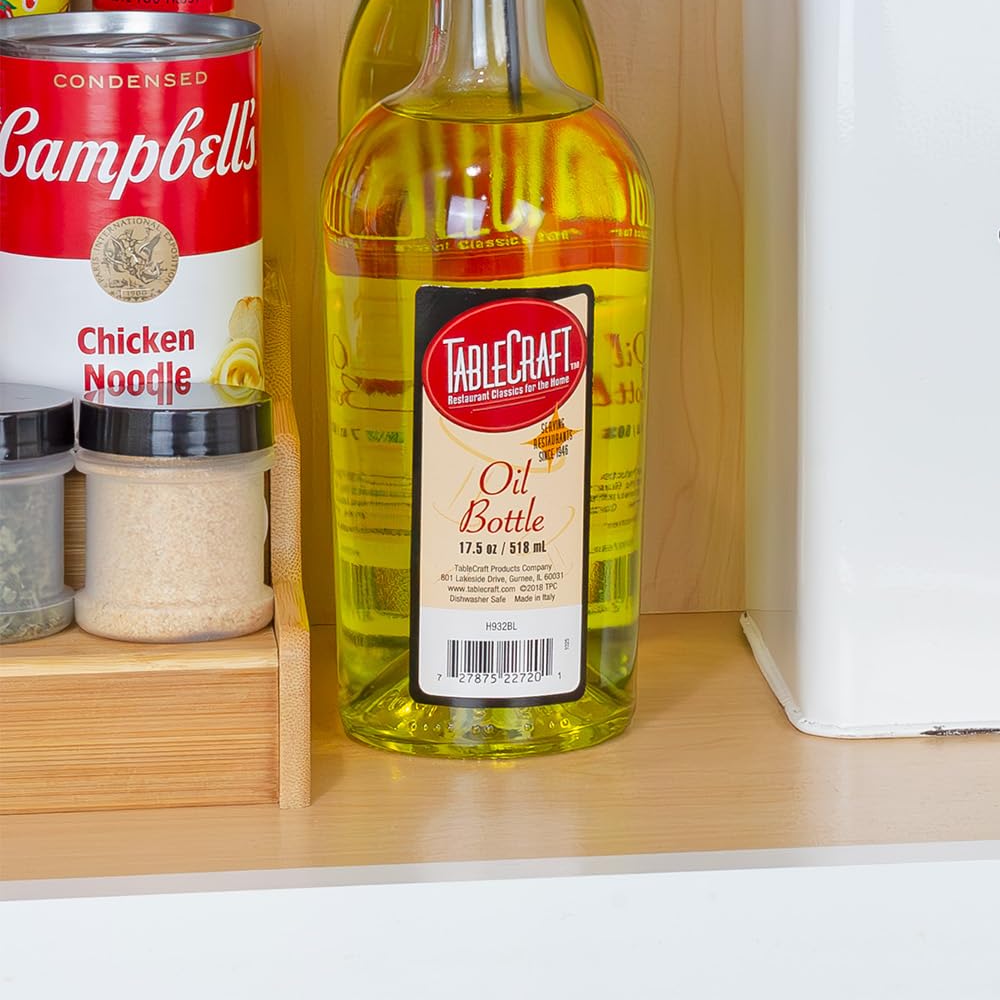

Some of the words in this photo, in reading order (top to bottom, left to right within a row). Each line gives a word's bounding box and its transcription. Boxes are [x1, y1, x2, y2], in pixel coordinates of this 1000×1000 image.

[53, 71, 208, 89] CONDENSED
[93, 217, 162, 252] INTERNATIONAL
[77, 325, 195, 355] Chicken
[84, 361, 192, 396] Noodle
[447, 390, 490, 405] Restaurant
[491, 386, 524, 400] Classics
[524, 383, 537, 393] for
[537, 380, 549, 390] the
[550, 375, 570, 387] Home
[541, 417, 565, 434] SERVING
[533, 429, 573, 450] RESTAURANTS
[480, 459, 532, 495] Oil
[459, 496, 545, 534] Bottle
[459, 541, 483, 554] 17.5
[486, 543, 497, 554] oz
[509, 541, 530, 554] 518
[533, 540, 547, 553] mL
[454, 564, 489, 573] TableCraft
[490, 565, 520, 573] Products
[522, 564, 552, 572] Company
[455, 575, 486, 583] Lakeside
[509, 574, 535, 583] Gurnee,
[544, 572, 564, 581] 60031
[448, 585, 516, 593] www.tablecraft.com
[449, 595, 489, 603] Dishwasher
[490, 595, 506, 603] Safe
[514, 595, 533, 603] Made
[542, 593, 556, 602] Italy
[485, 622, 518, 631] H932BL
[436, 673, 443, 681] 7
[458, 673, 497, 684] 27875
[503, 672, 541, 684] 22720
